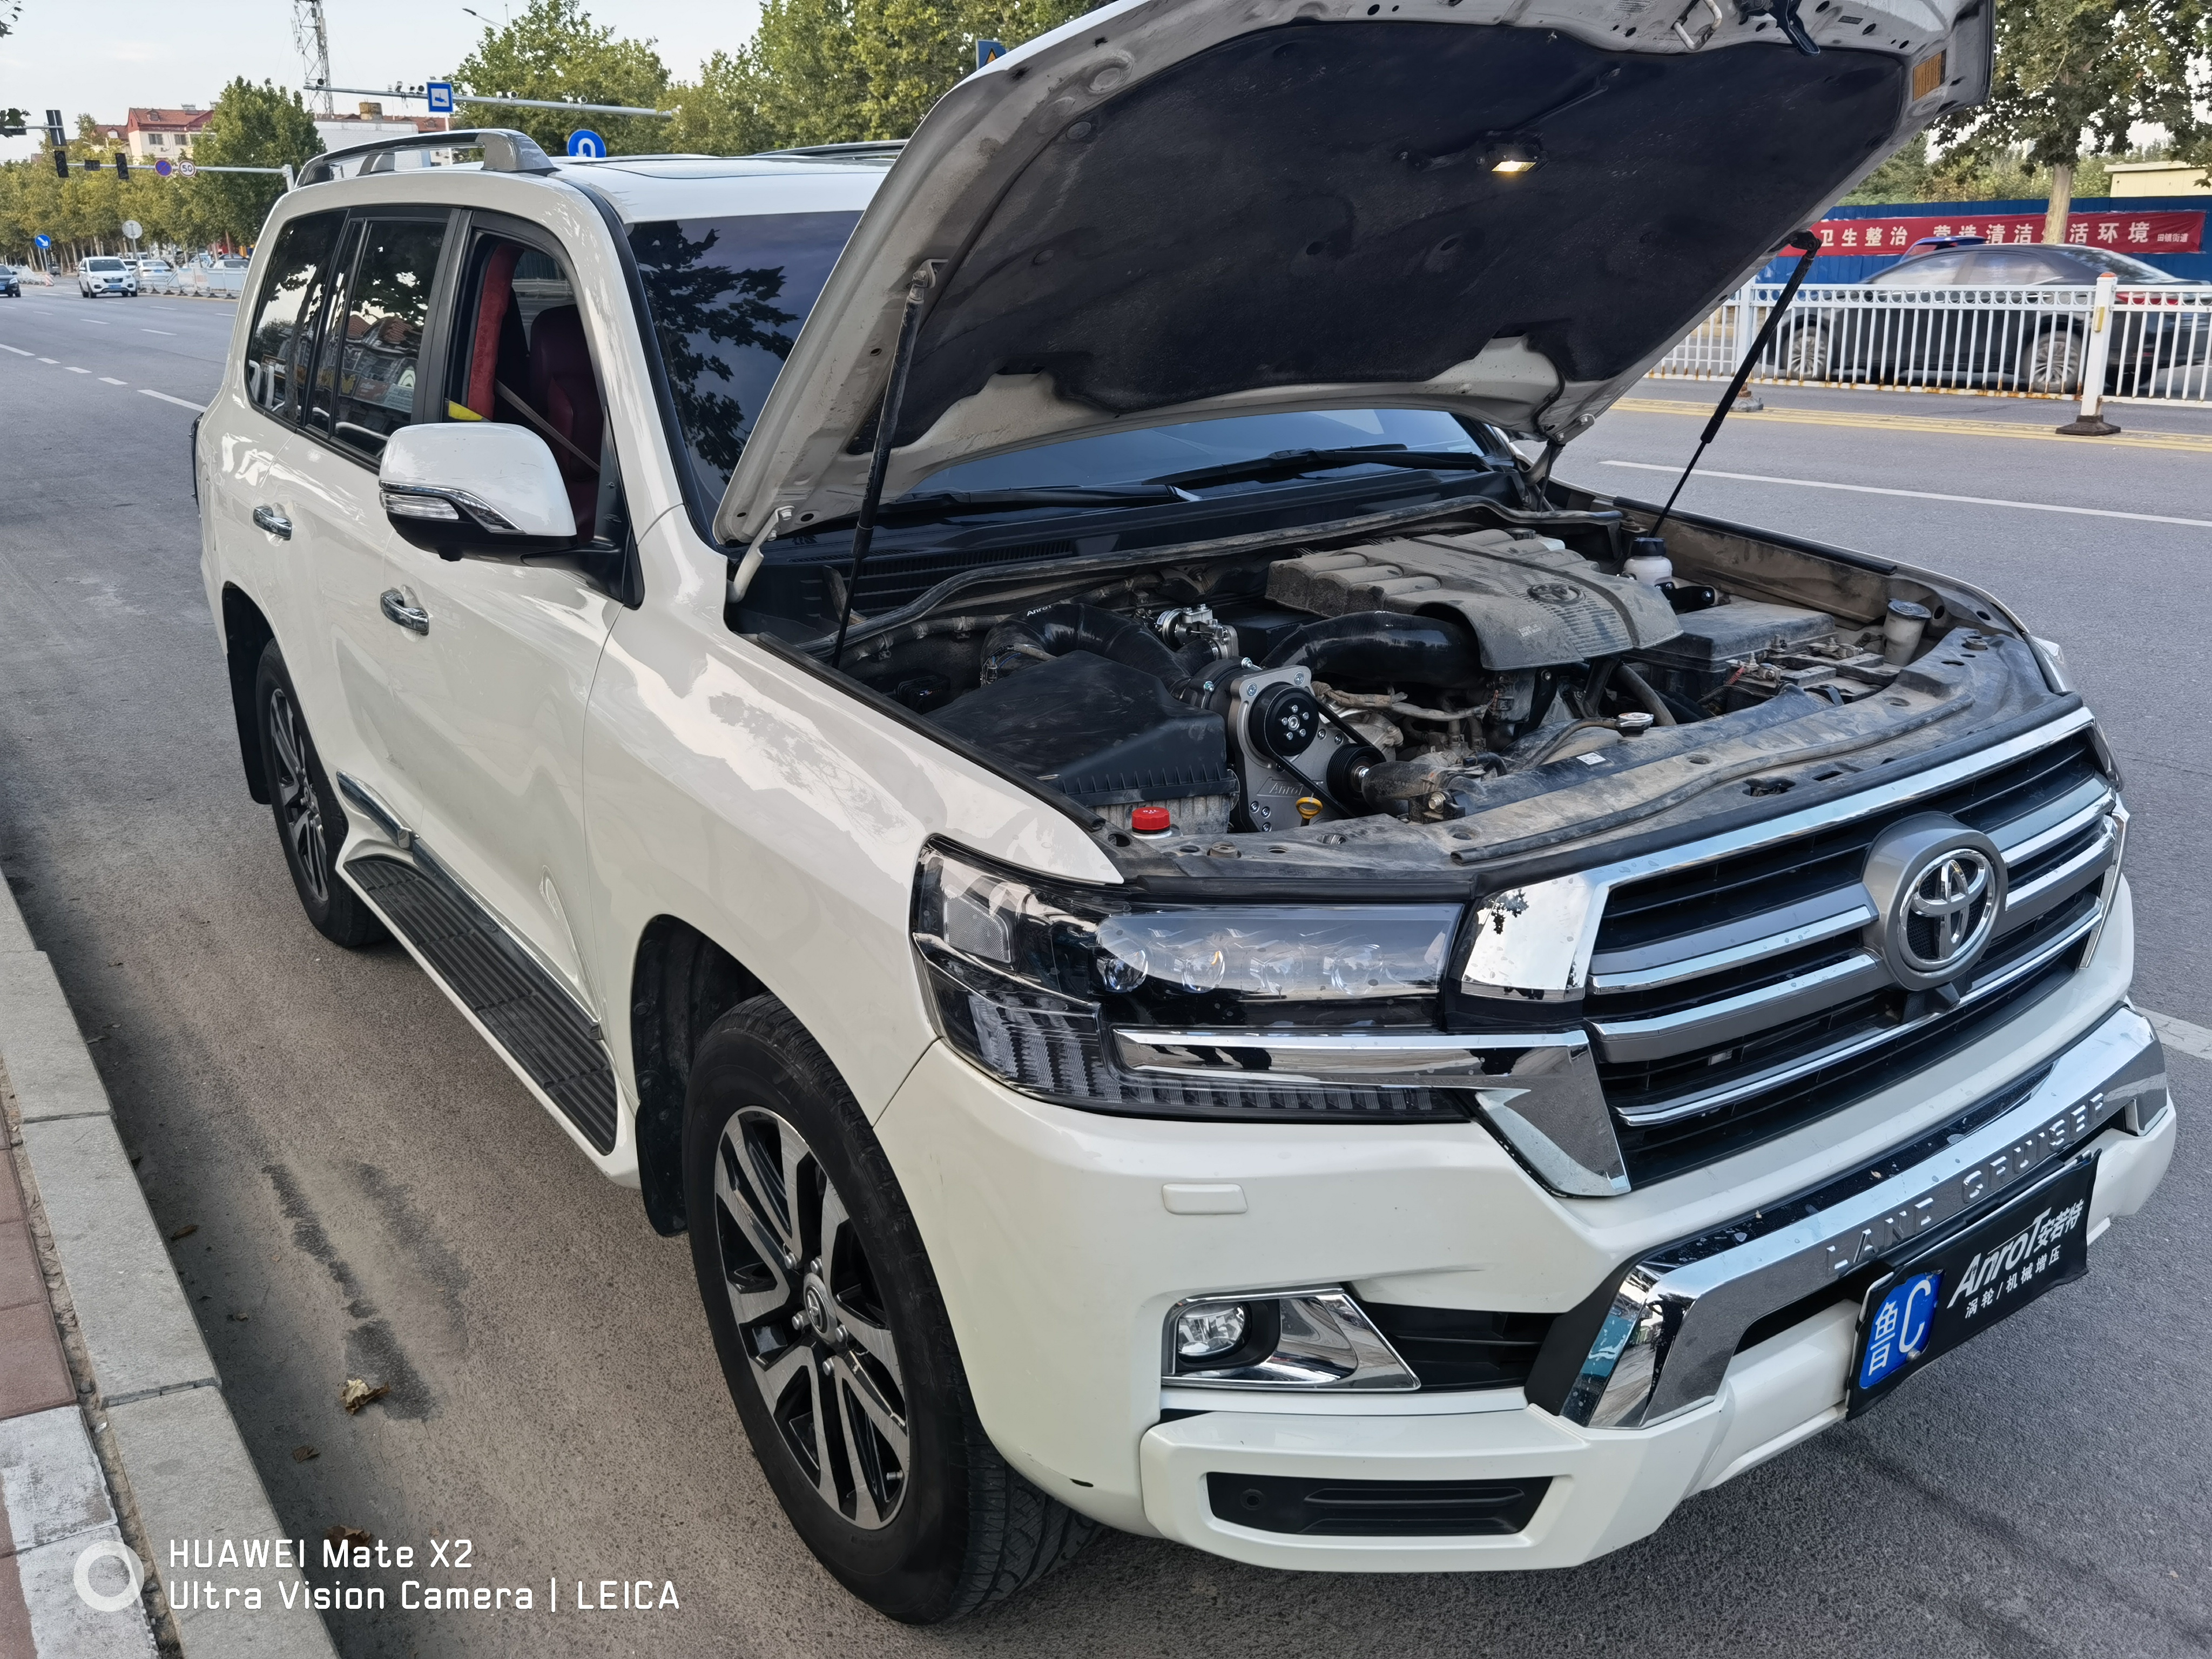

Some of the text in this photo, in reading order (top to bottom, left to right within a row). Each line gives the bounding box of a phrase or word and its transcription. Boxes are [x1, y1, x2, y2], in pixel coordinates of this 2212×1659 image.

[1820, 226, 1908, 246] 卫生整治
[1965, 1244, 2061, 1319] 涡轮/机械增压
